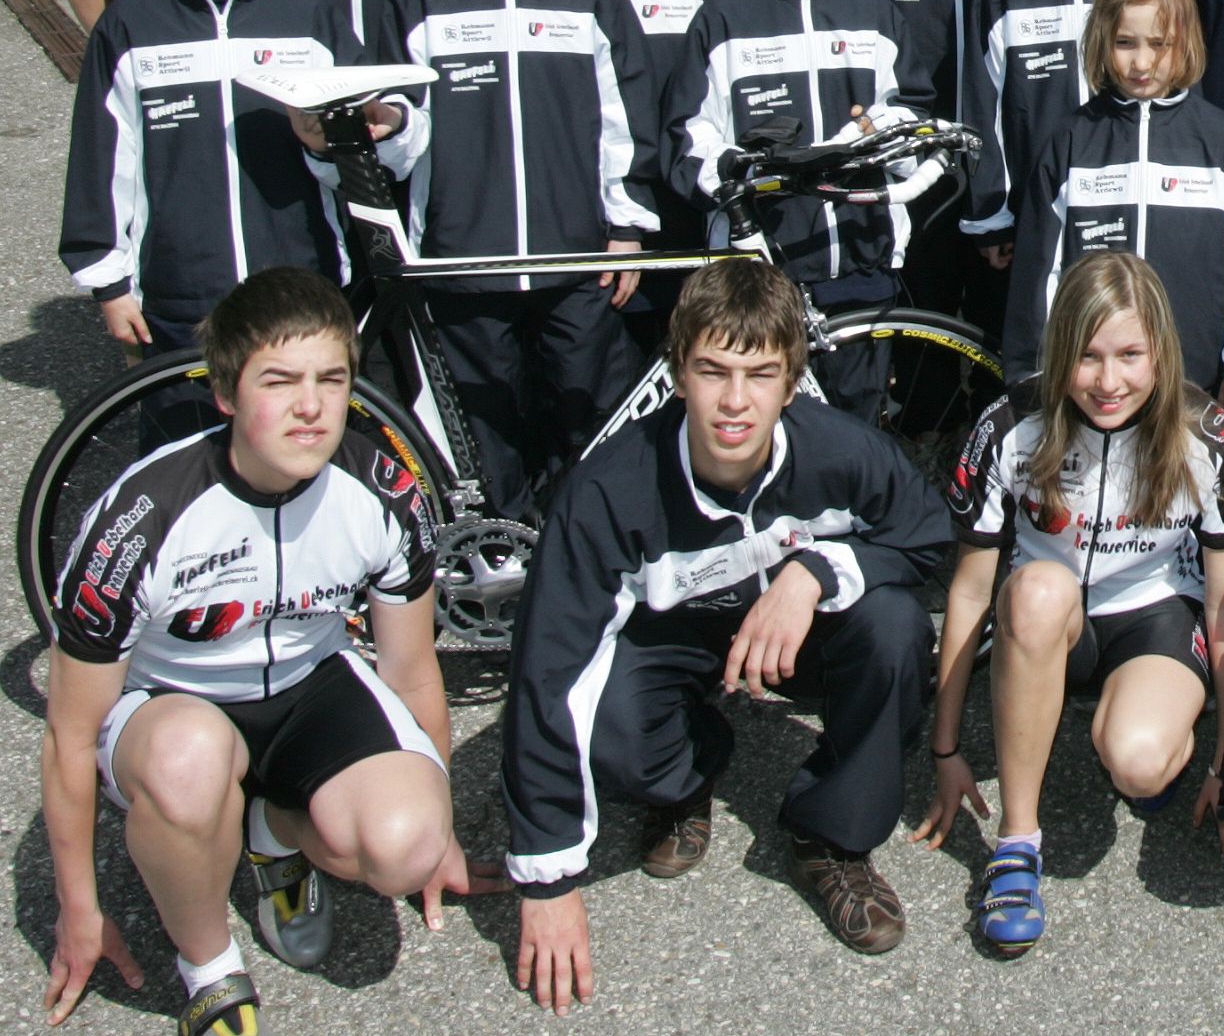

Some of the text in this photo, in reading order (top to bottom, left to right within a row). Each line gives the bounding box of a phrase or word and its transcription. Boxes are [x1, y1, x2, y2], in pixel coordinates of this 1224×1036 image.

[902, 329, 950, 345] COSMIC
[96, 494, 155, 558] Uebelhardt
[252, 597, 296, 617] Erich
